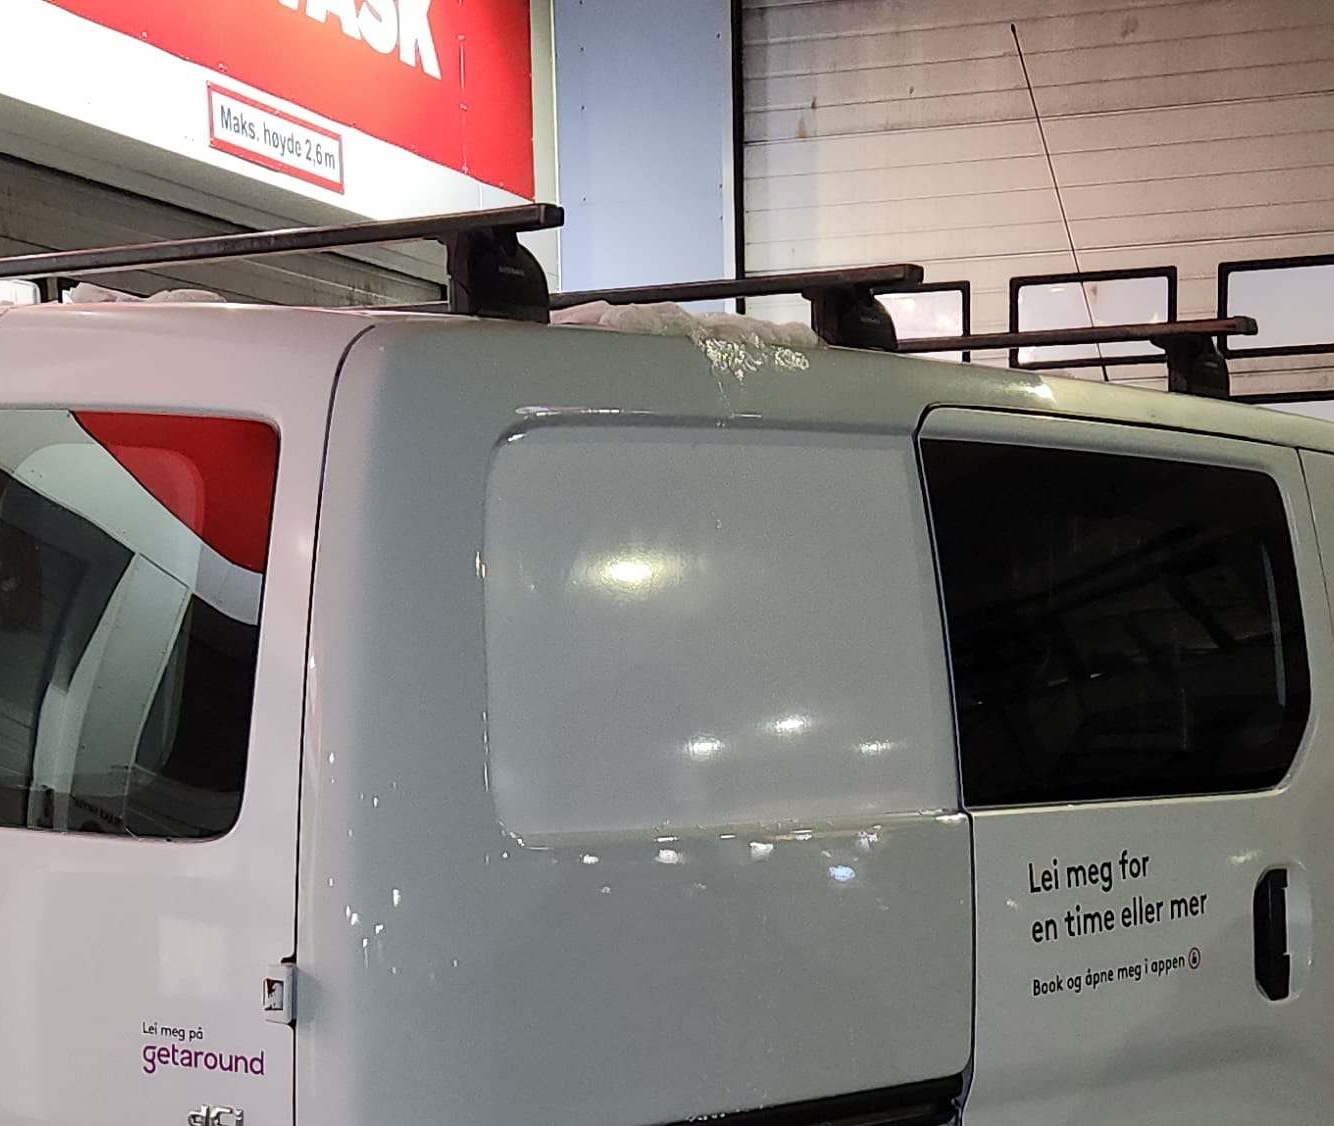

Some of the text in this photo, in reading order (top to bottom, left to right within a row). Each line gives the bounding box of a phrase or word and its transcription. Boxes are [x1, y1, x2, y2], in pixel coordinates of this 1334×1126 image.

[220, 104, 260, 142] Maks.
[263, 121, 302, 157] høyde
[1028, 850, 1150, 893] Lei meg for
[1032, 894, 1207, 943] en time eller mer
[1033, 975, 1064, 996] Book
[1067, 975, 1082, 993] og
[1085, 968, 1114, 989] åpne
[1117, 963, 1142, 981] meg
[1151, 954, 1185, 976] appen
[142, 1022, 204, 1042] Lei meg på
[142, 1044, 264, 1076] getaround
